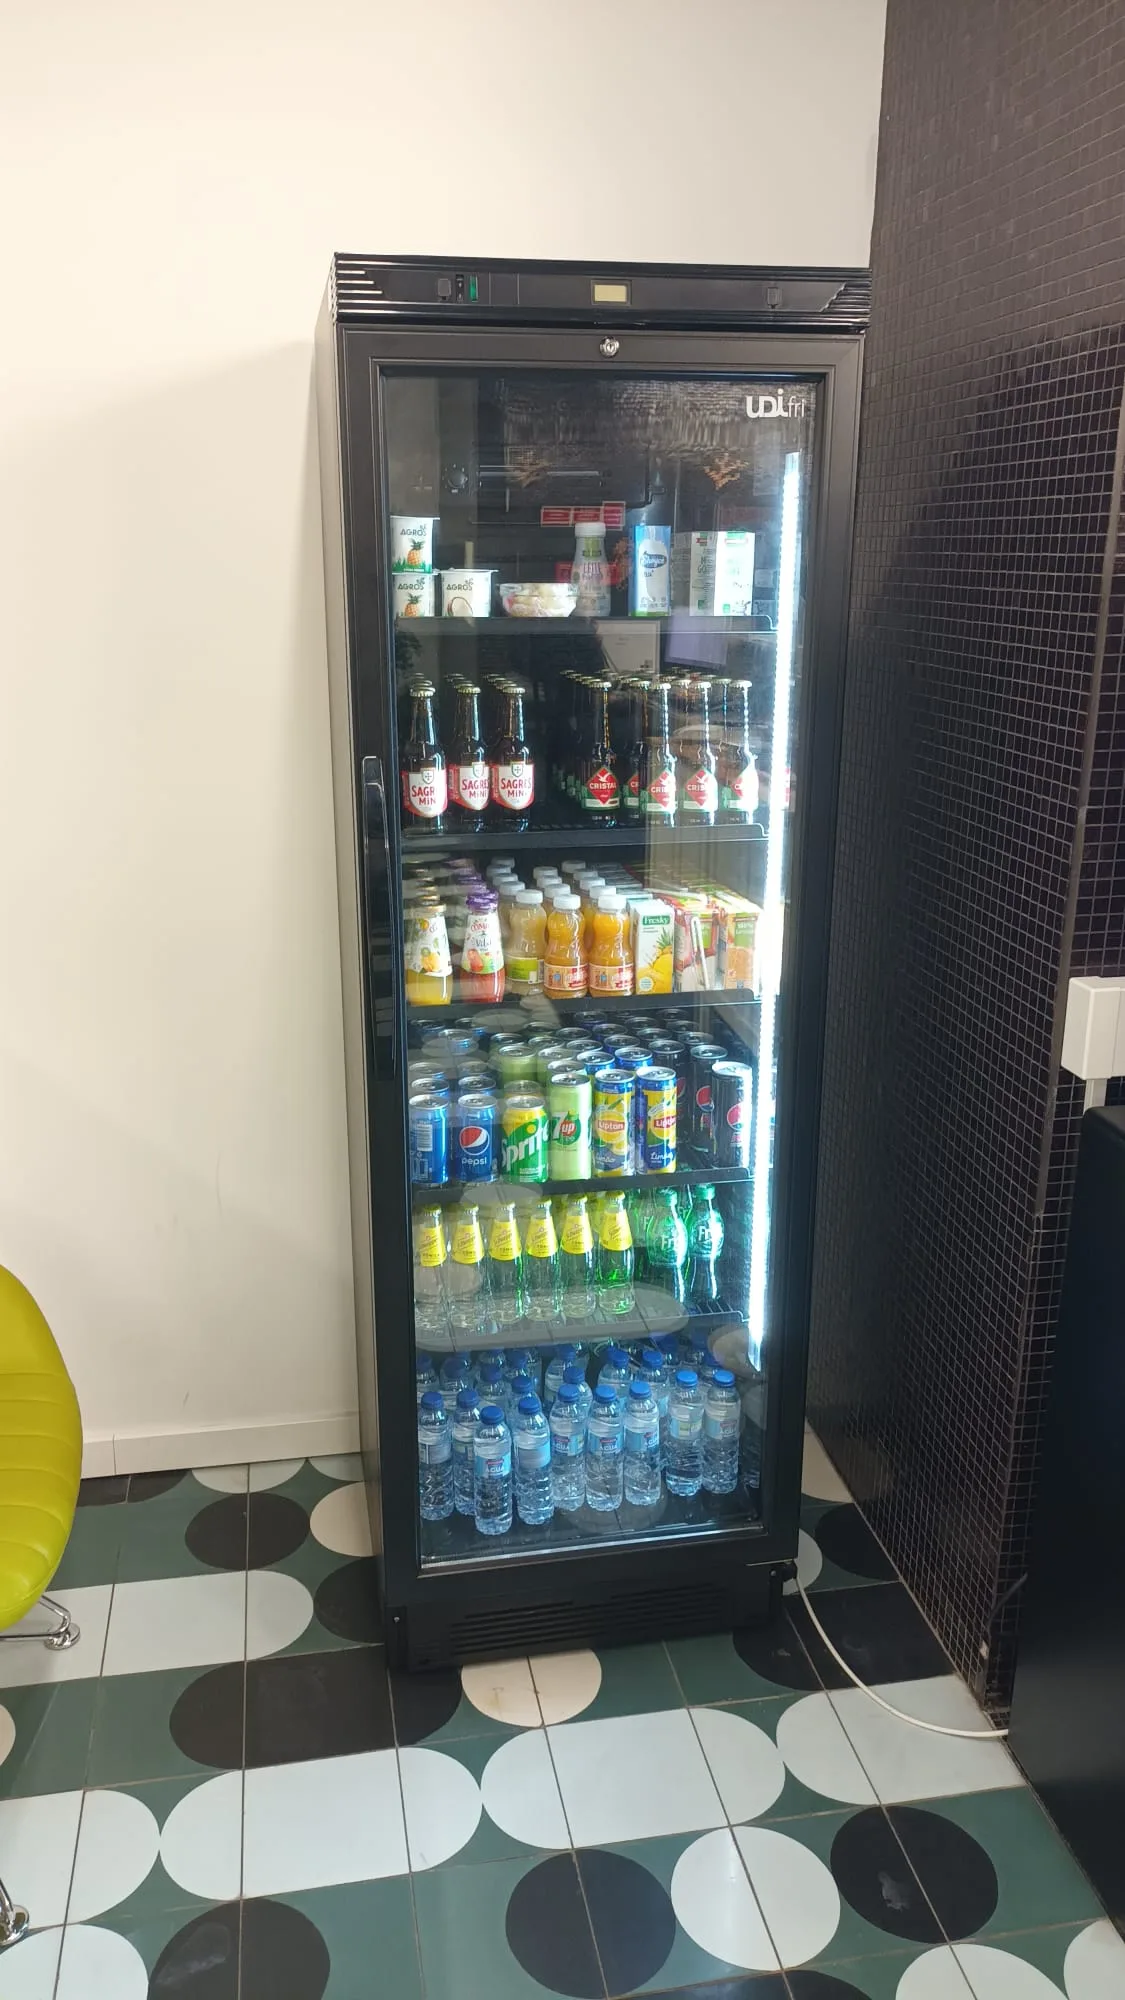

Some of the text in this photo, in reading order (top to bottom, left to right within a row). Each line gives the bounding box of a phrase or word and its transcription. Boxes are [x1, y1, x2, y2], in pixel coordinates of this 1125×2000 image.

[400, 528, 427, 537] AGROS
[398, 583, 424, 591] AGROS
[447, 583, 473, 592] AGROS
[599, 1121, 624, 1130] Lipton
[461, 1157, 487, 1166] pepsi
